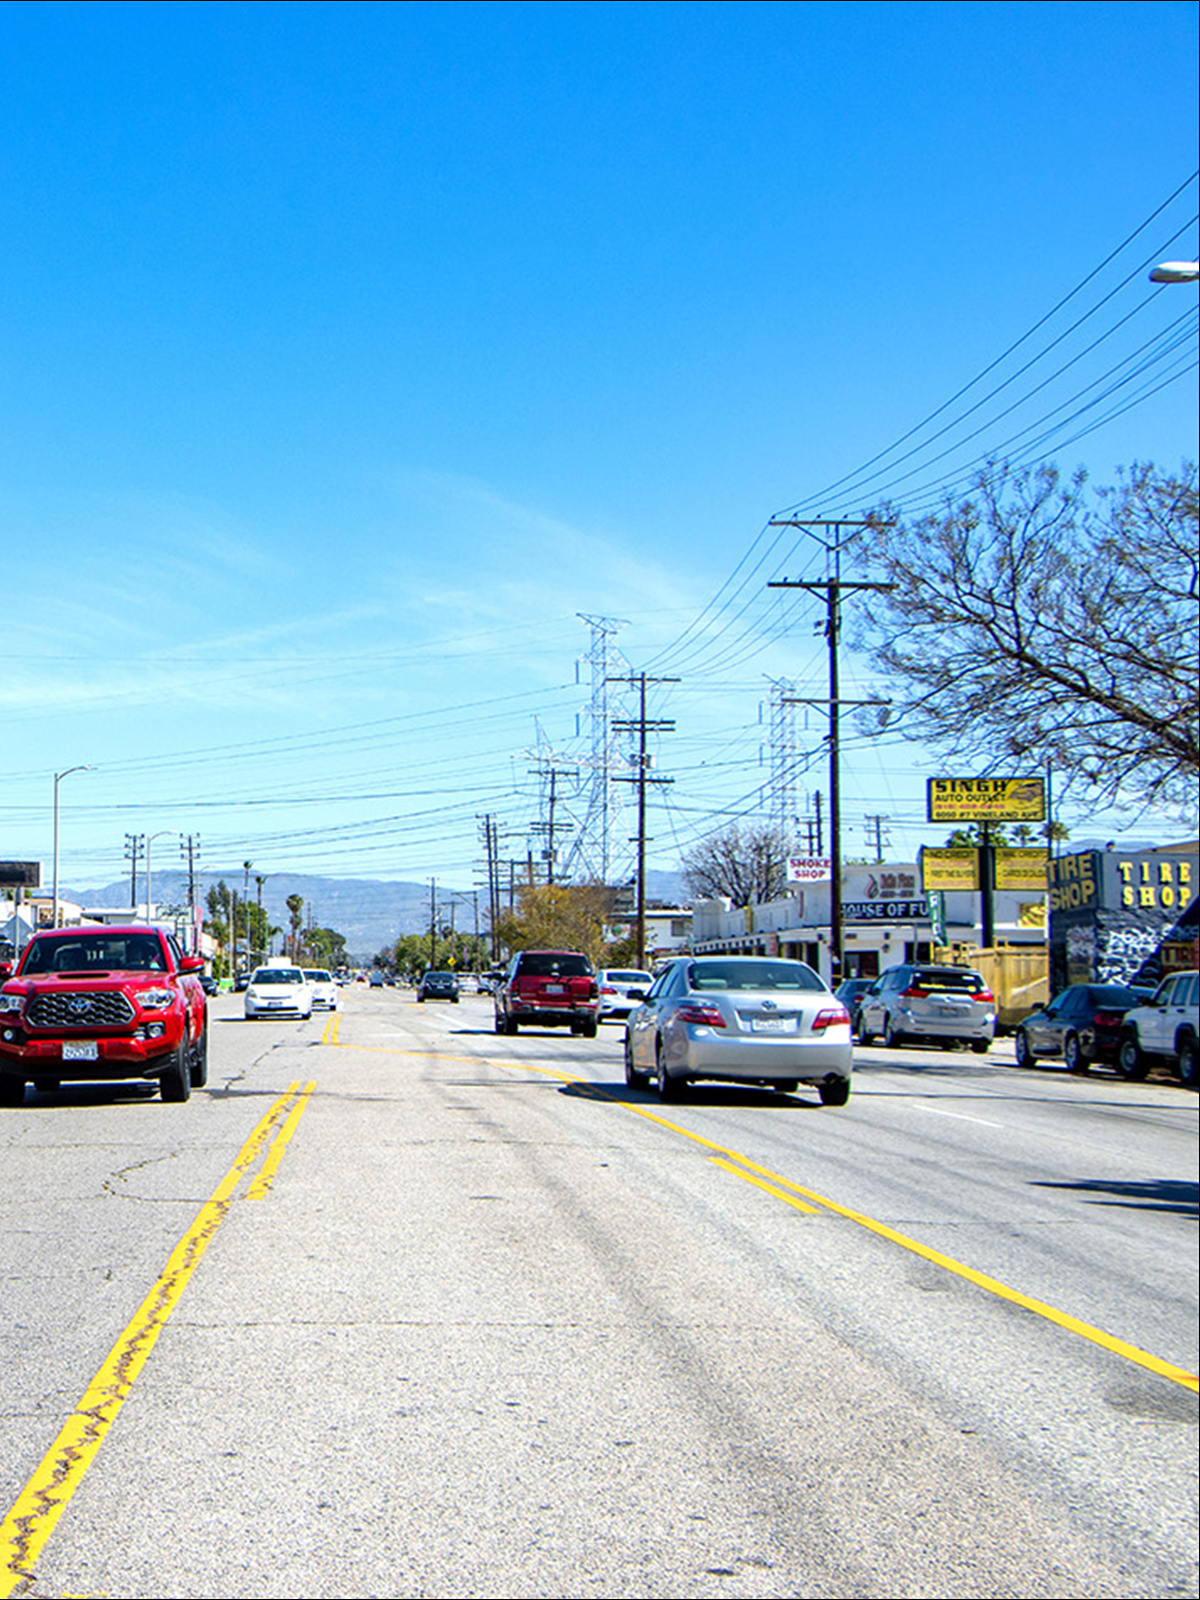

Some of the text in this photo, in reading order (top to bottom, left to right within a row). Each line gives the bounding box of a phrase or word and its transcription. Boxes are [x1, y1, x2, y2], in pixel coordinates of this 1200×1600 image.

[935, 780, 1007, 792] SINGH
[935, 793, 1006, 802] AUTO OUTLET
[972, 810, 1019, 818] VINELAND
[790, 859, 831, 868] SMOKE
[1047, 854, 1093, 882] TIRE
[794, 870, 826, 878] SHOP
[1119, 862, 1191, 883] TIRE
[1050, 880, 1095, 910] SHOP
[1123, 886, 1191, 907] SHOP
[887, 903, 906, 917] OF
[909, 903, 929, 917] FU
